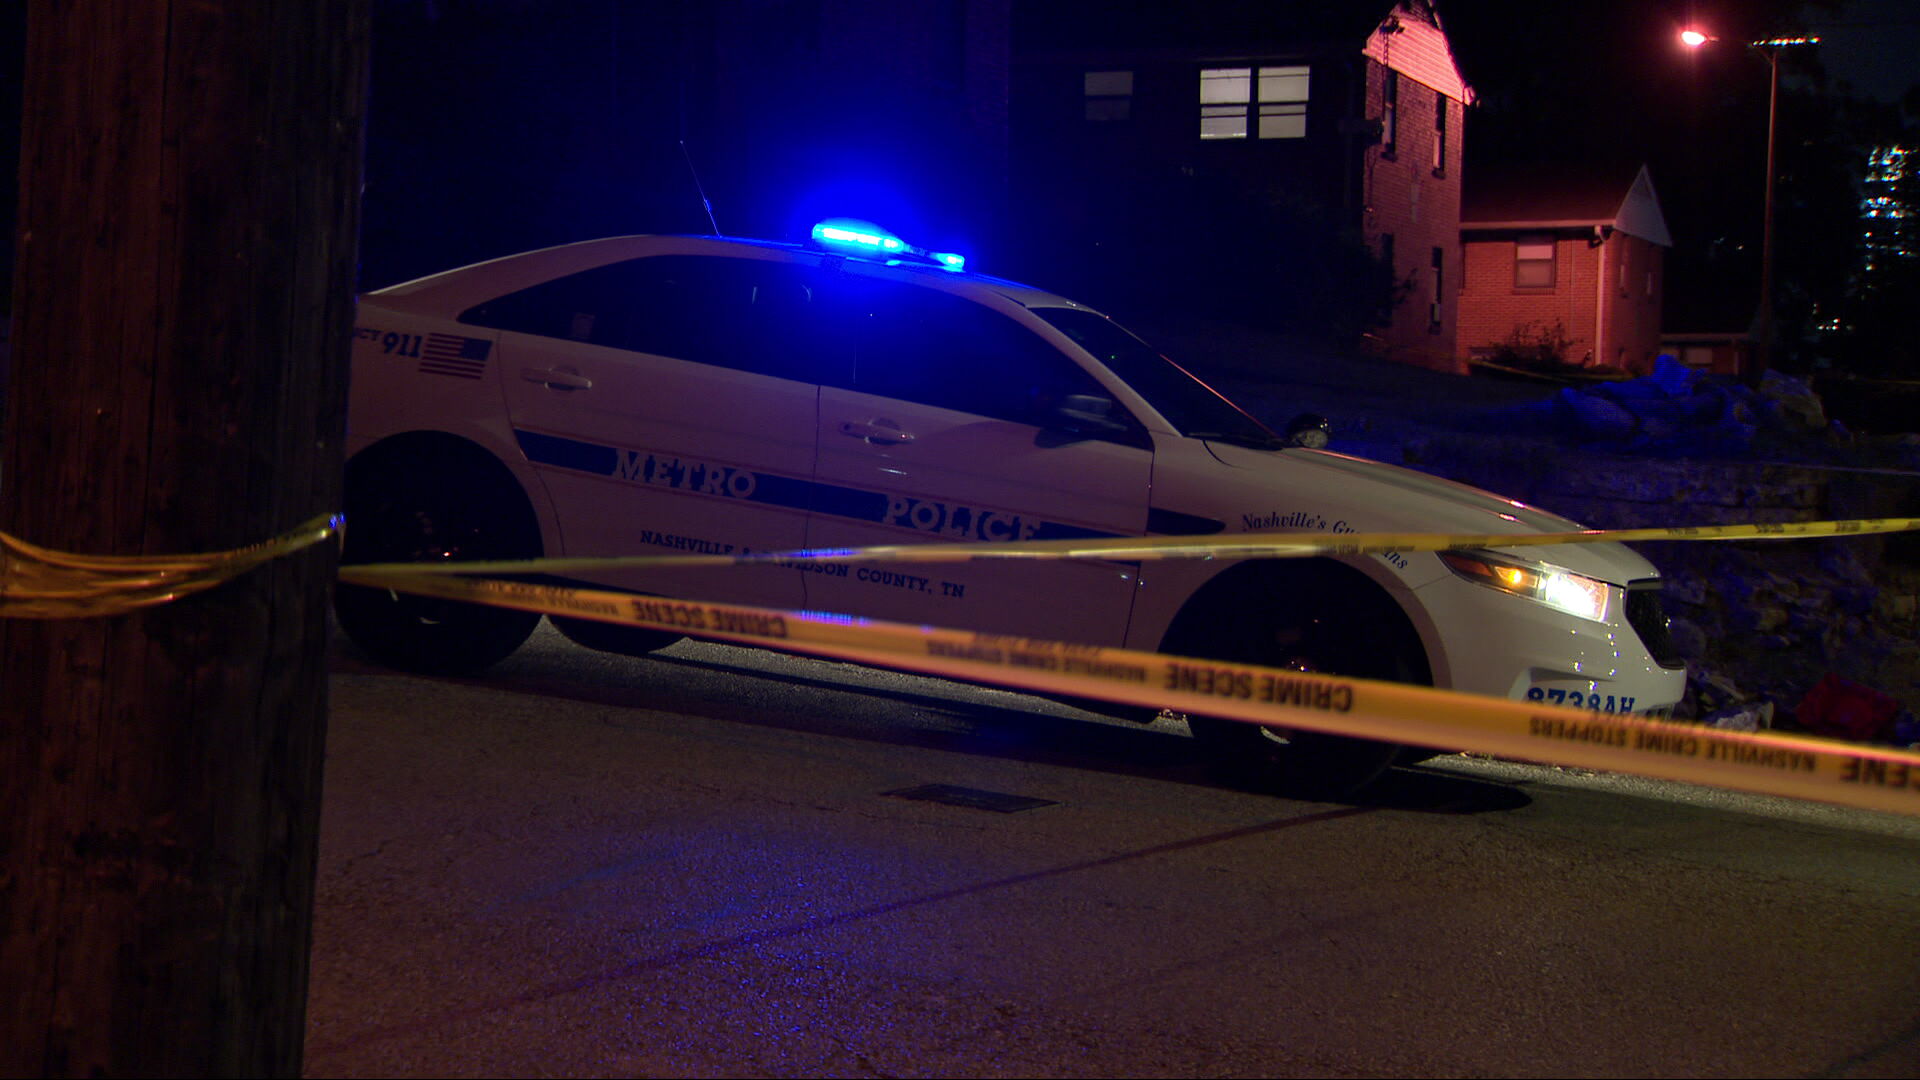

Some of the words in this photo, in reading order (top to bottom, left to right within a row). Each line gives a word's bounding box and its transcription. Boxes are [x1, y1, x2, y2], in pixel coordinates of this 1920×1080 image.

[383, 332, 422, 357] 911
[611, 447, 758, 499] METRO
[882, 494, 1041, 543] POLICE
[1242, 511, 1326, 532] Nashville's
[640, 530, 734, 556] NASHVILLE
[857, 567, 933, 594] COUNTY,
[942, 581, 965, 598] TN
[631, 599, 705, 629] SCENE
[709, 607, 788, 638] CRIME
[1167, 663, 1252, 699] SCENE
[1260, 674, 1354, 712] CRIME
[1530, 716, 1628, 748] STOPPERS
[1637, 730, 1698, 757] CRIME
[1840, 756, 1920, 794] ENE
